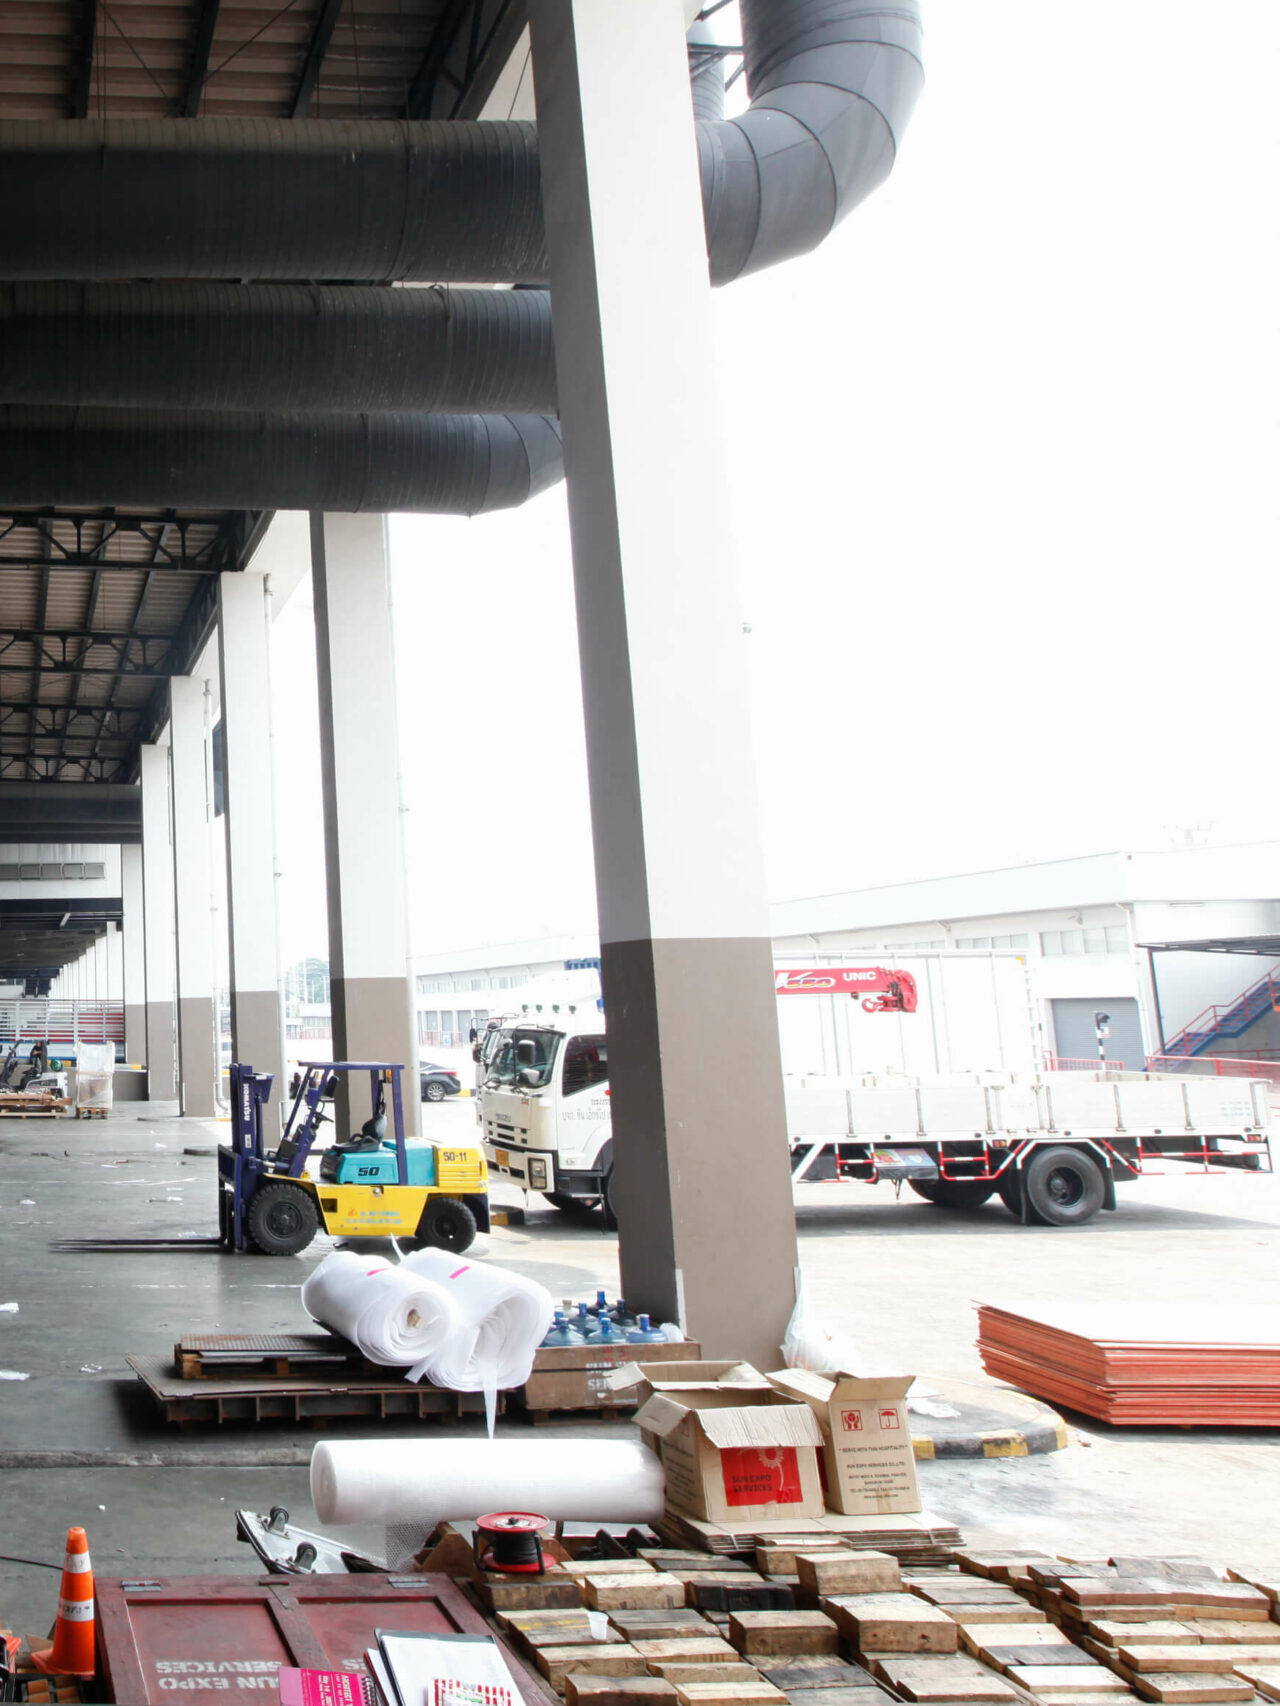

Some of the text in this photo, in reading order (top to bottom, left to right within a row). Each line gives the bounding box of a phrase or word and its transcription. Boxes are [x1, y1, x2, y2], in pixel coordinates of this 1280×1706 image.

[843, 971, 877, 981] UNIC
[243, 1083, 251, 1121] KOMATSU
[443, 1152, 468, 1162] 50-11
[358, 1166, 380, 1177] 50
[732, 1474, 772, 1483] SUN EXPO
[732, 1484, 773, 1493] SERVICES
[156, 1658, 283, 1674] SERVICES
[158, 1676, 230, 1690] EXPO
